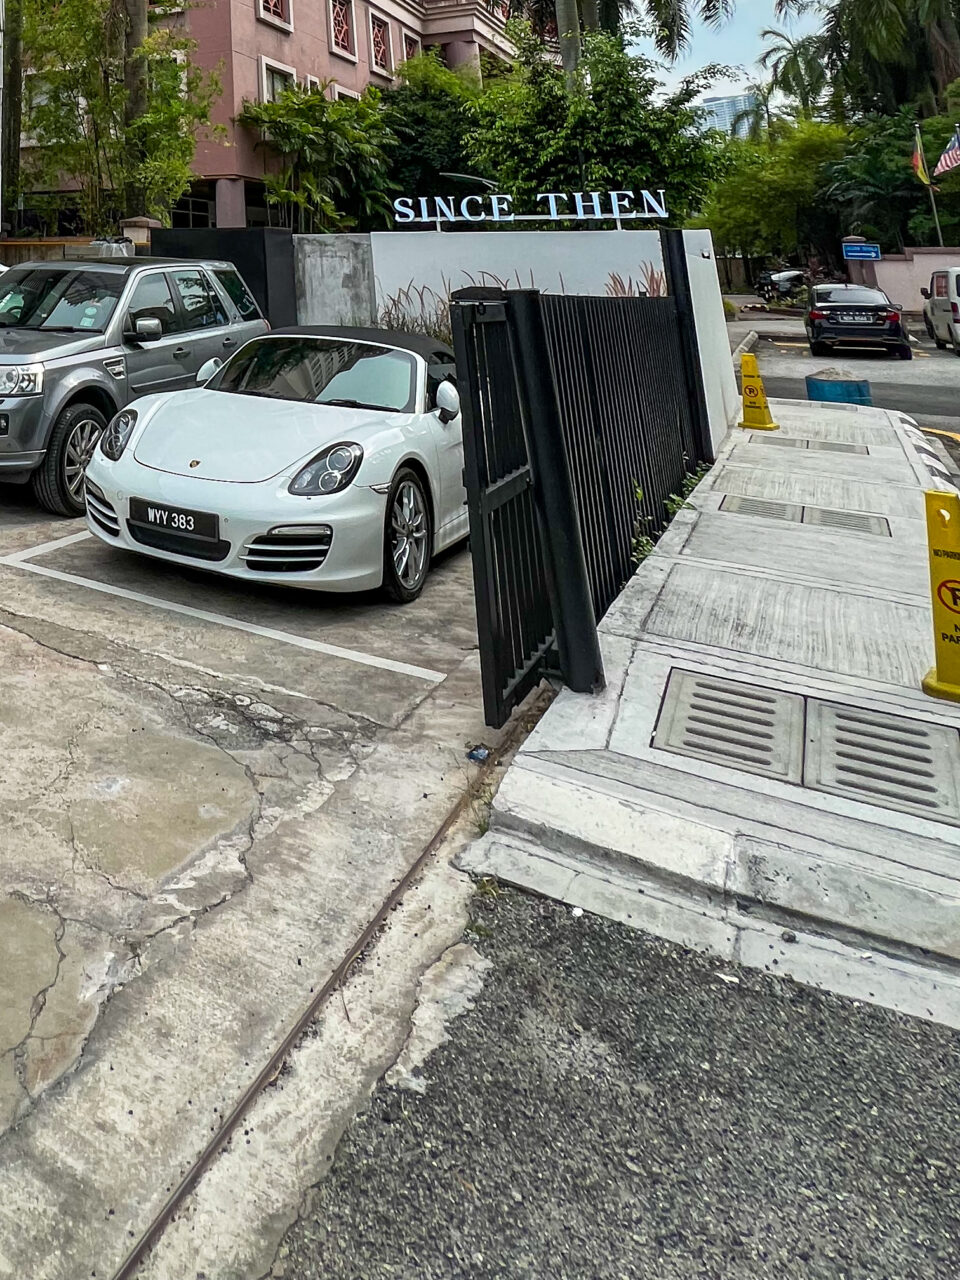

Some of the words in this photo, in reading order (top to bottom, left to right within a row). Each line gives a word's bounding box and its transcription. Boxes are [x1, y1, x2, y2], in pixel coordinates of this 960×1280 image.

[393, 193, 516, 223] SINCE
[536, 188, 669, 221] THEN
[147, 507, 169, 525] WYY
[171, 512, 195, 531] 383
